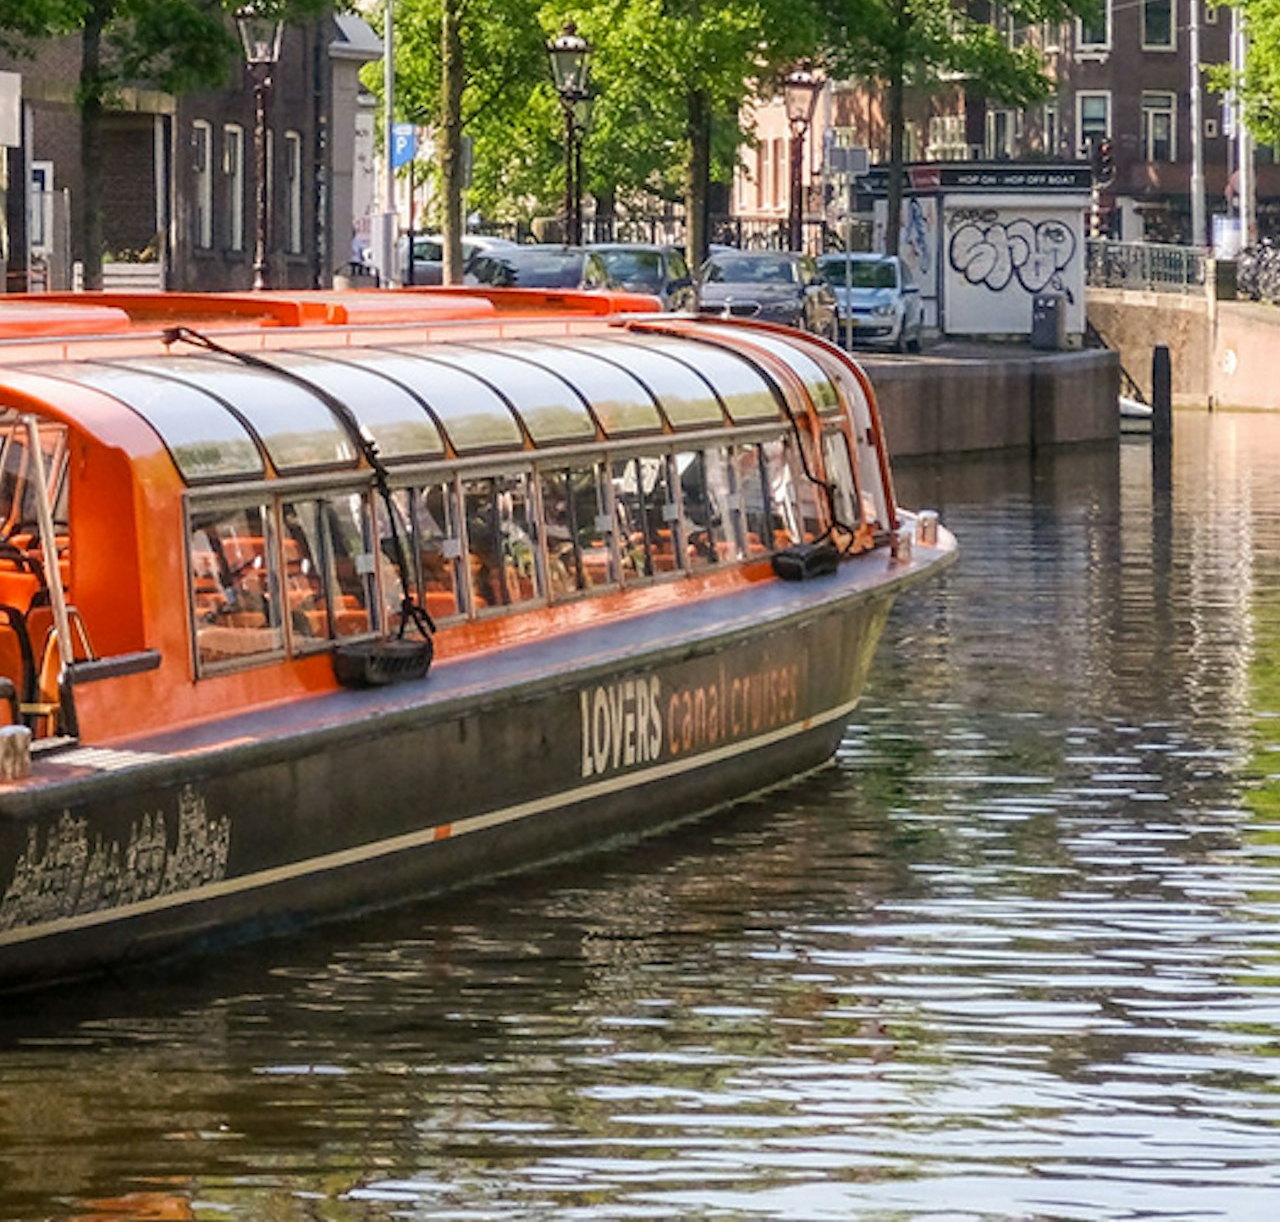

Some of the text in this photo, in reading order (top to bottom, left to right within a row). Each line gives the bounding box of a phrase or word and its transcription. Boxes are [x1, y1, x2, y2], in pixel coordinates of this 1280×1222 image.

[396, 136, 408, 155] P
[958, 174, 1076, 185] HOP ON HOP OFF BOAT
[580, 651, 799, 779] LOVERS canal cruises
